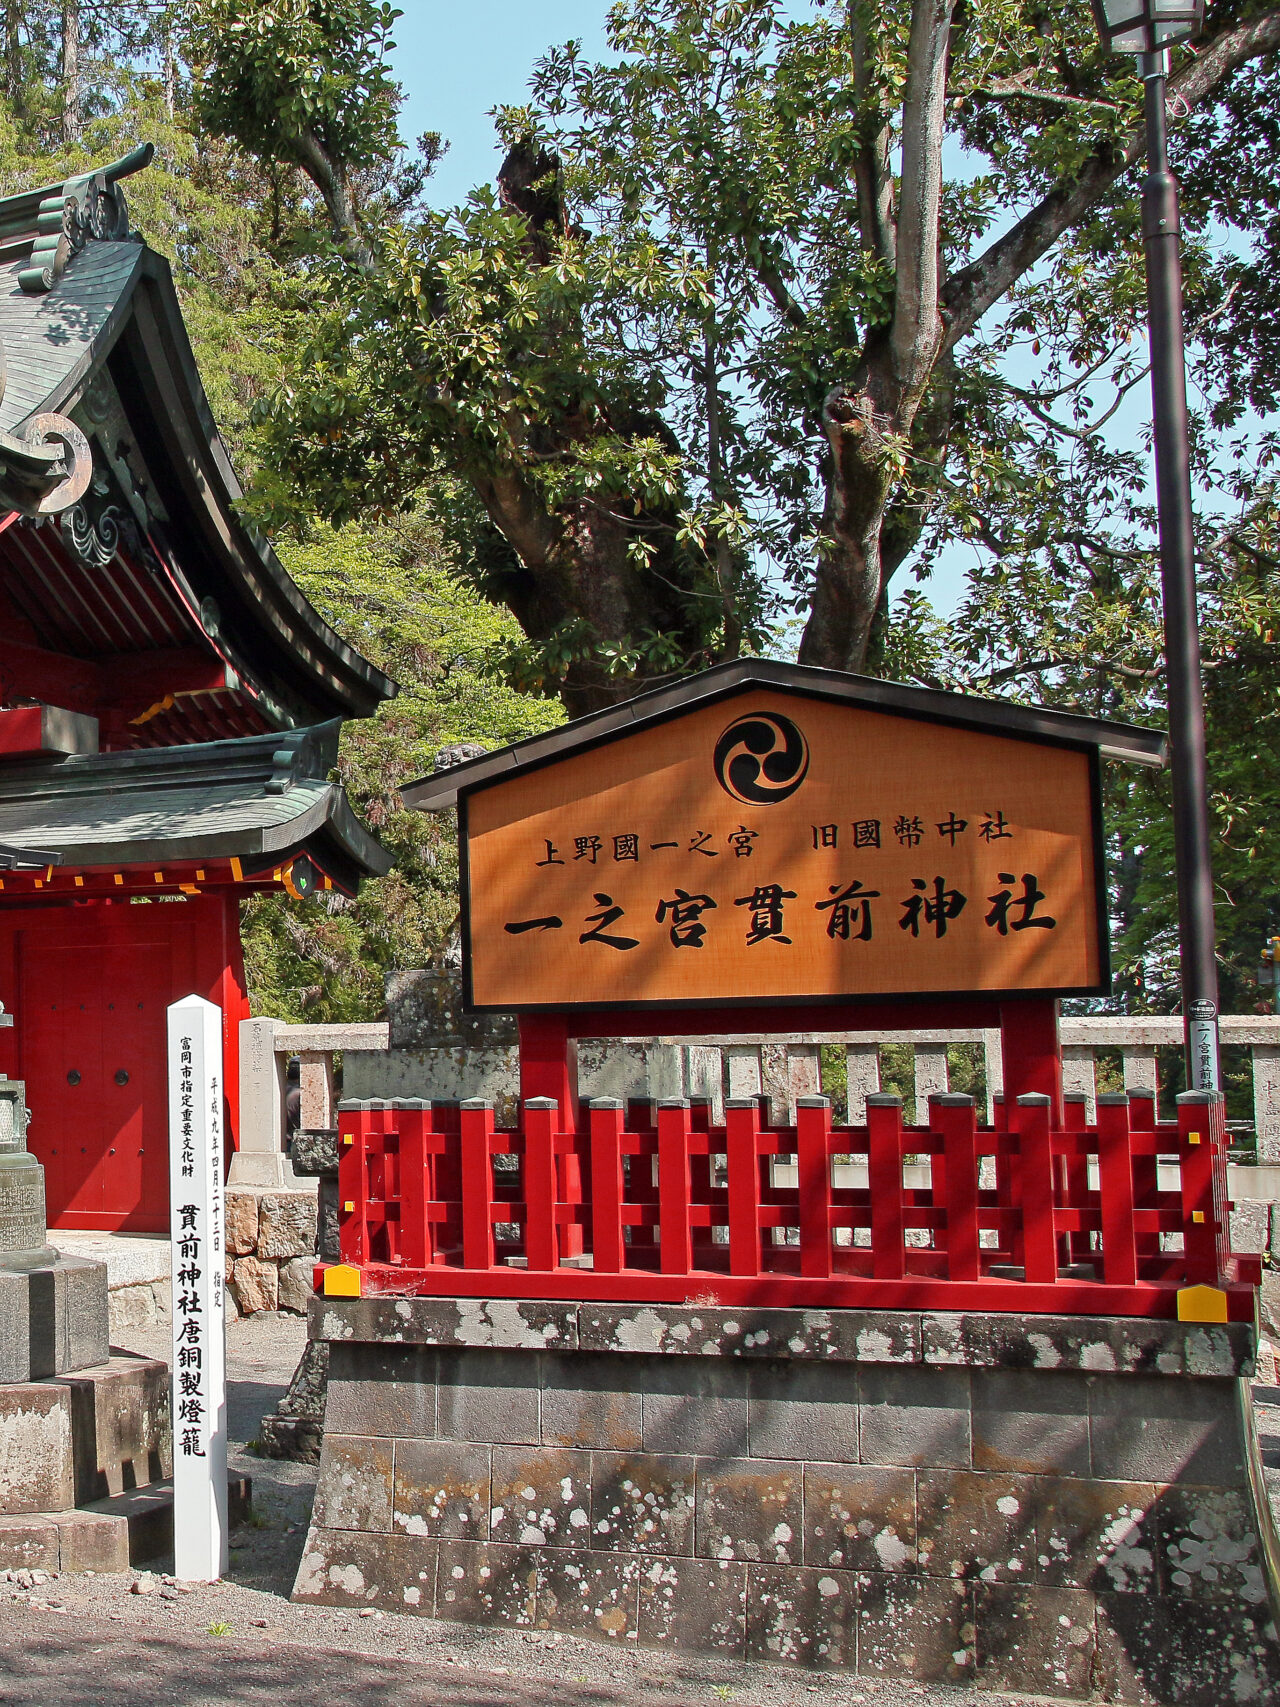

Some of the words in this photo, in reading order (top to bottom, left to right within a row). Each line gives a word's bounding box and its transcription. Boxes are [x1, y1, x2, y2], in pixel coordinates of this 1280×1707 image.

[535, 825, 760, 867] 上野國一之宮
[810, 810, 1013, 850] 旧國幣中社
[503, 871, 1057, 951] 一之宮貫前神社
[179, 1036, 195, 1178] 富岡市指定重要文化財
[209, 1077, 221, 1251] 平成九年四月二十三日
[175, 1203, 207, 1458] 貫前神社唐銅製燈籠
